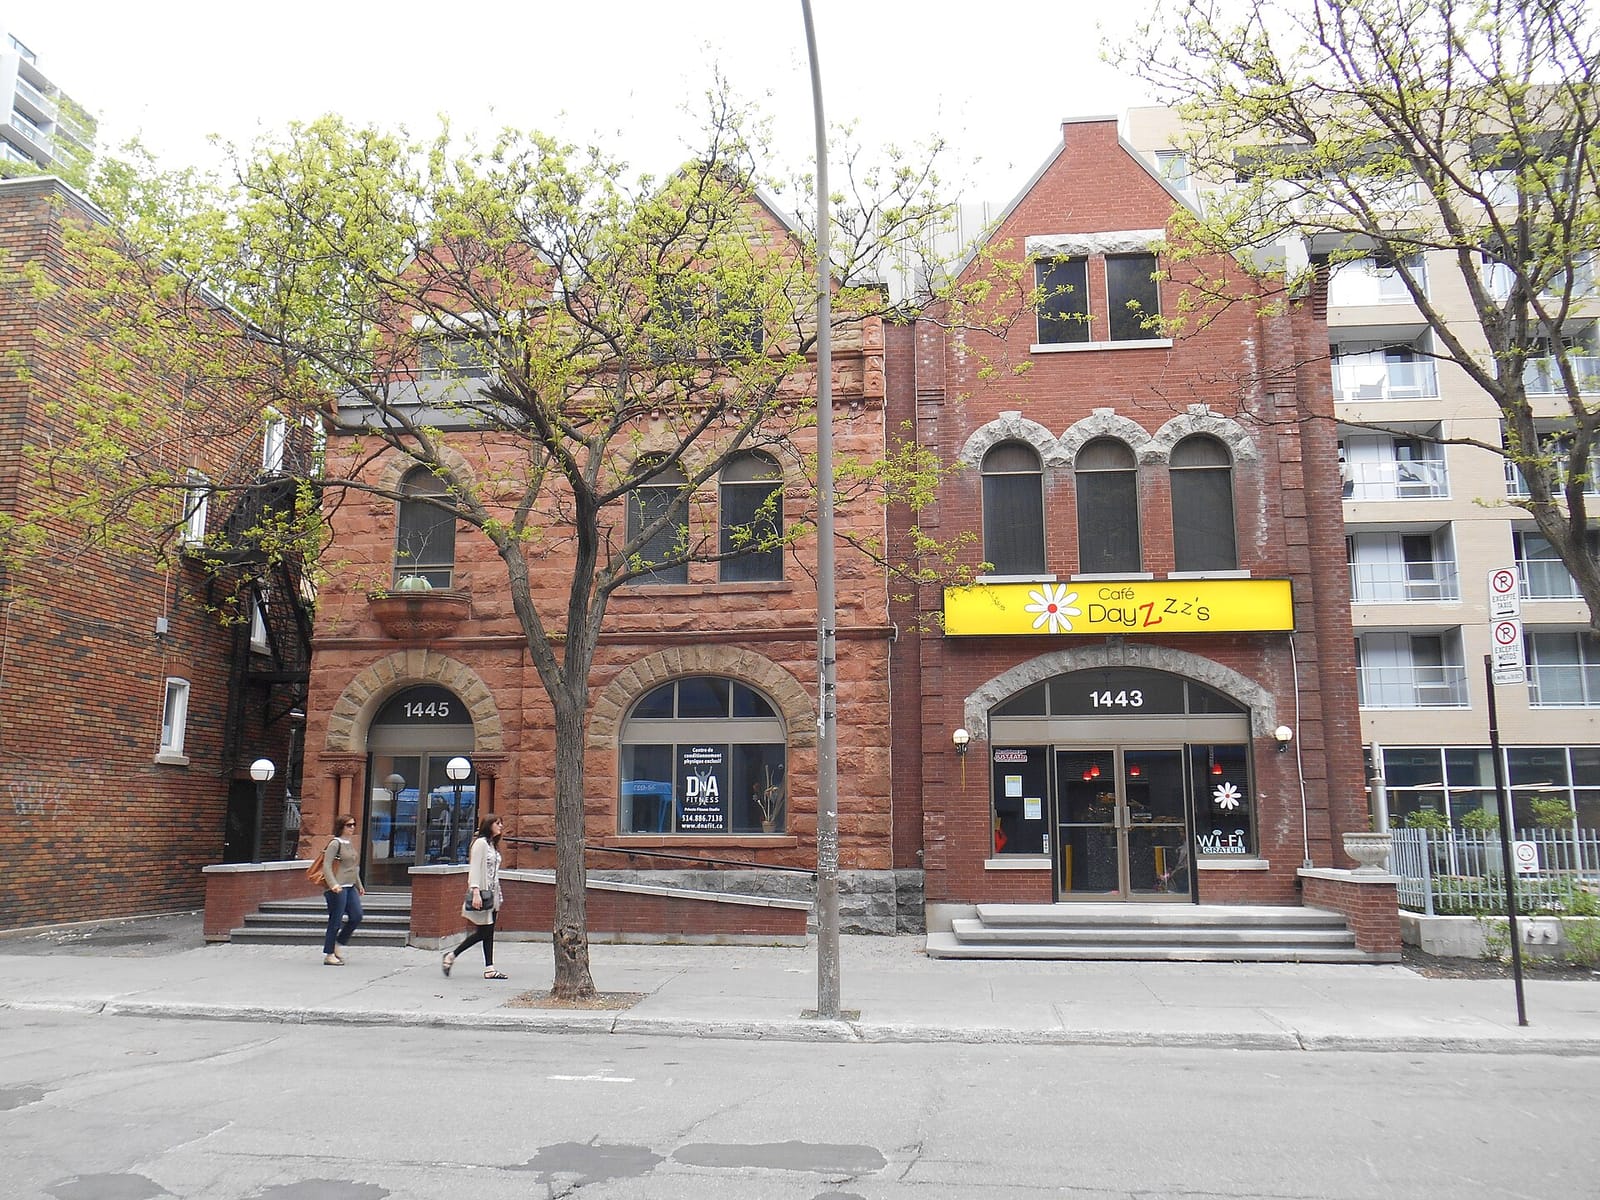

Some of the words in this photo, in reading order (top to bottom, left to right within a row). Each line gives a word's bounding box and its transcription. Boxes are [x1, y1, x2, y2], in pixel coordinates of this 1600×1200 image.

[1098, 587, 1135, 600] Café
[1089, 689, 1143, 708] 1443
[404, 702, 449, 717] 1445
[686, 776, 719, 797] DNA
[1203, 846, 1246, 854] GRATUIT
